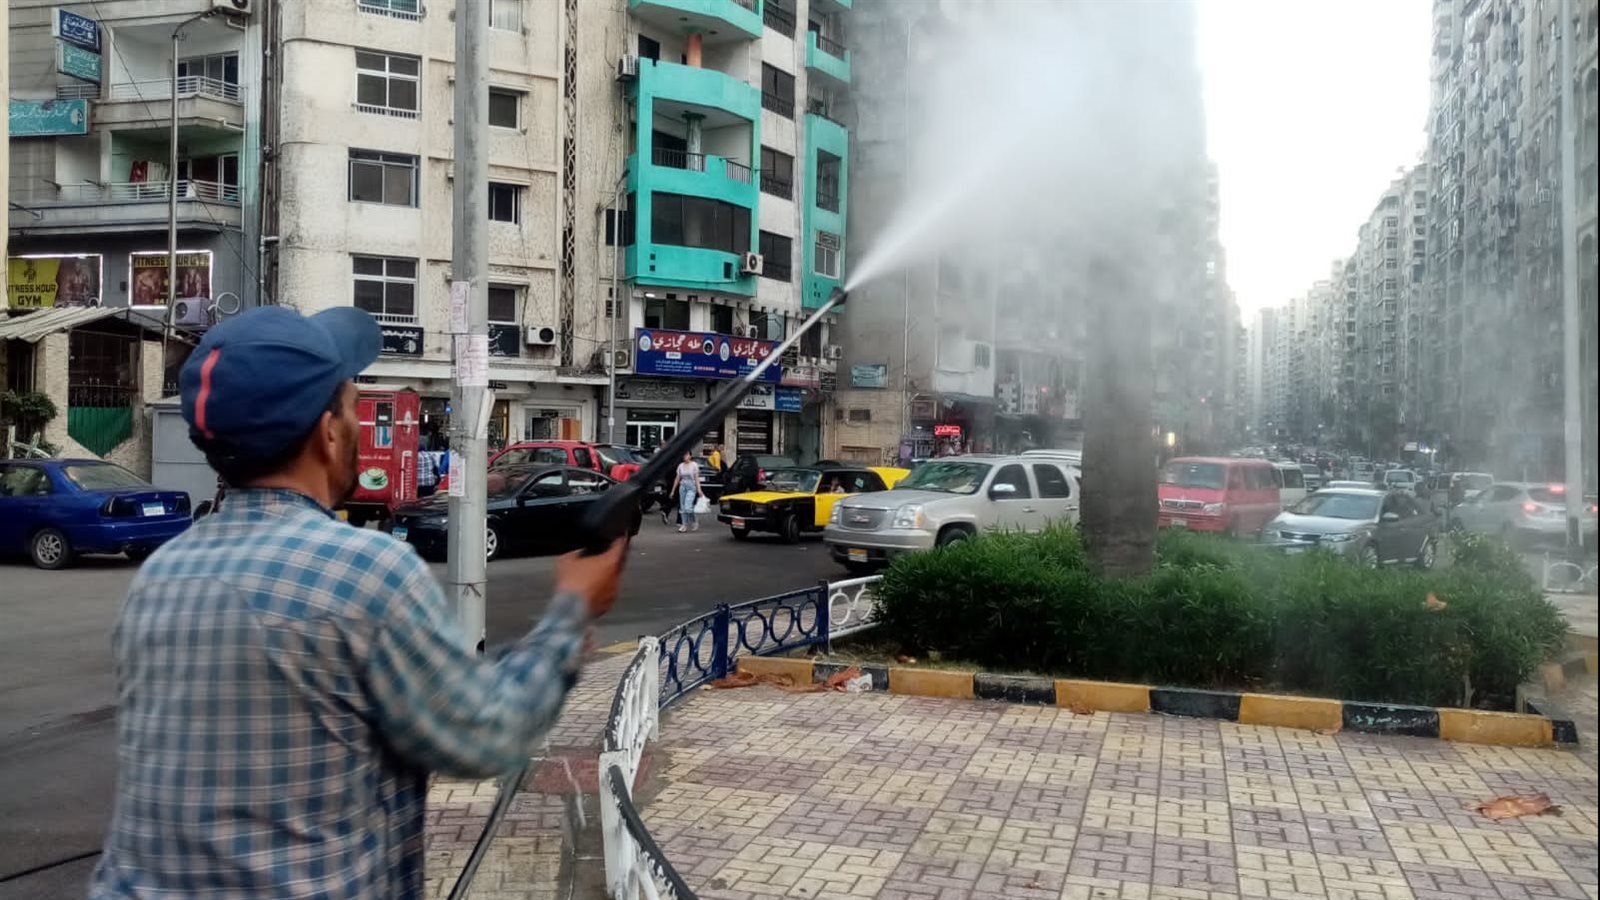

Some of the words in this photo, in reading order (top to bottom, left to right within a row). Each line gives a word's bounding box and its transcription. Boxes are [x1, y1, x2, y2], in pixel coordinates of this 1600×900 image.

[17, 295, 42, 306] GYM
[652, 334, 686, 350] حجازي
[687, 338, 701, 349] طه
[733, 341, 758, 357] حجازي
[759, 346, 769, 357] طه
